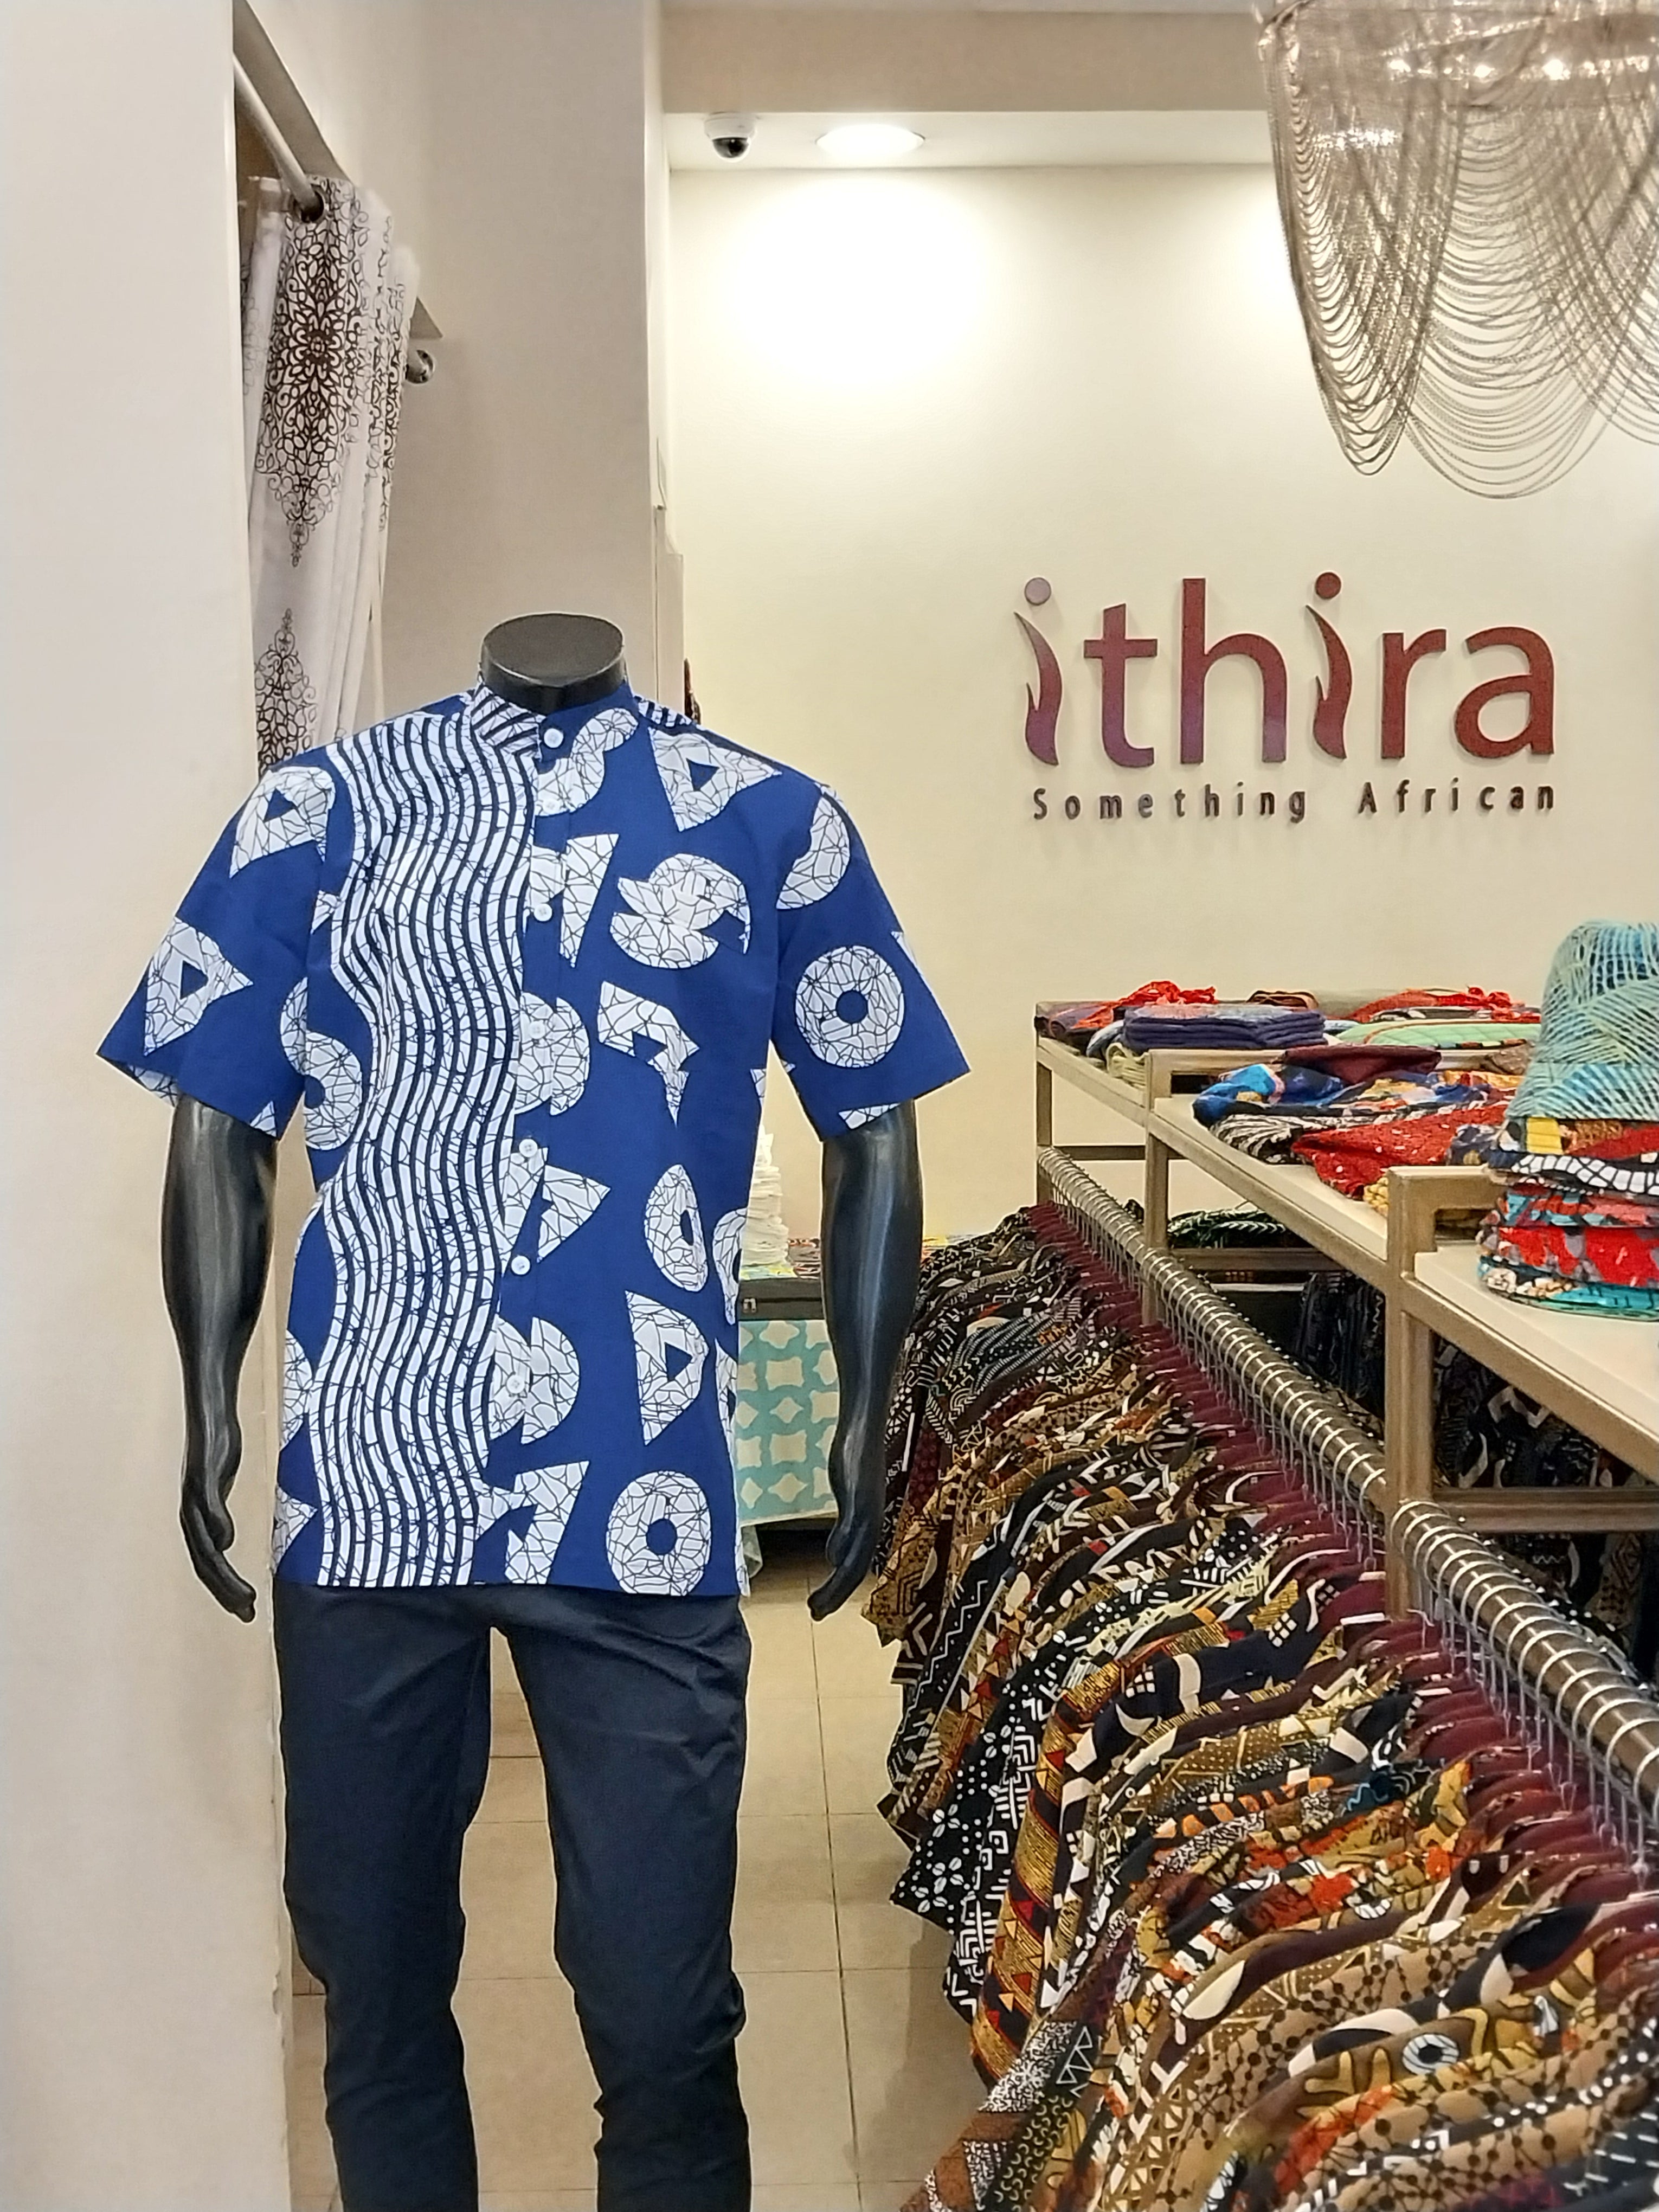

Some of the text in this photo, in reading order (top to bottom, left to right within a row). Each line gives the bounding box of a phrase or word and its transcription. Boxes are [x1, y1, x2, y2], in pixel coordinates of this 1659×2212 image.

[1014, 571, 1555, 768] ithira
[1033, 777, 1555, 824] Something African
